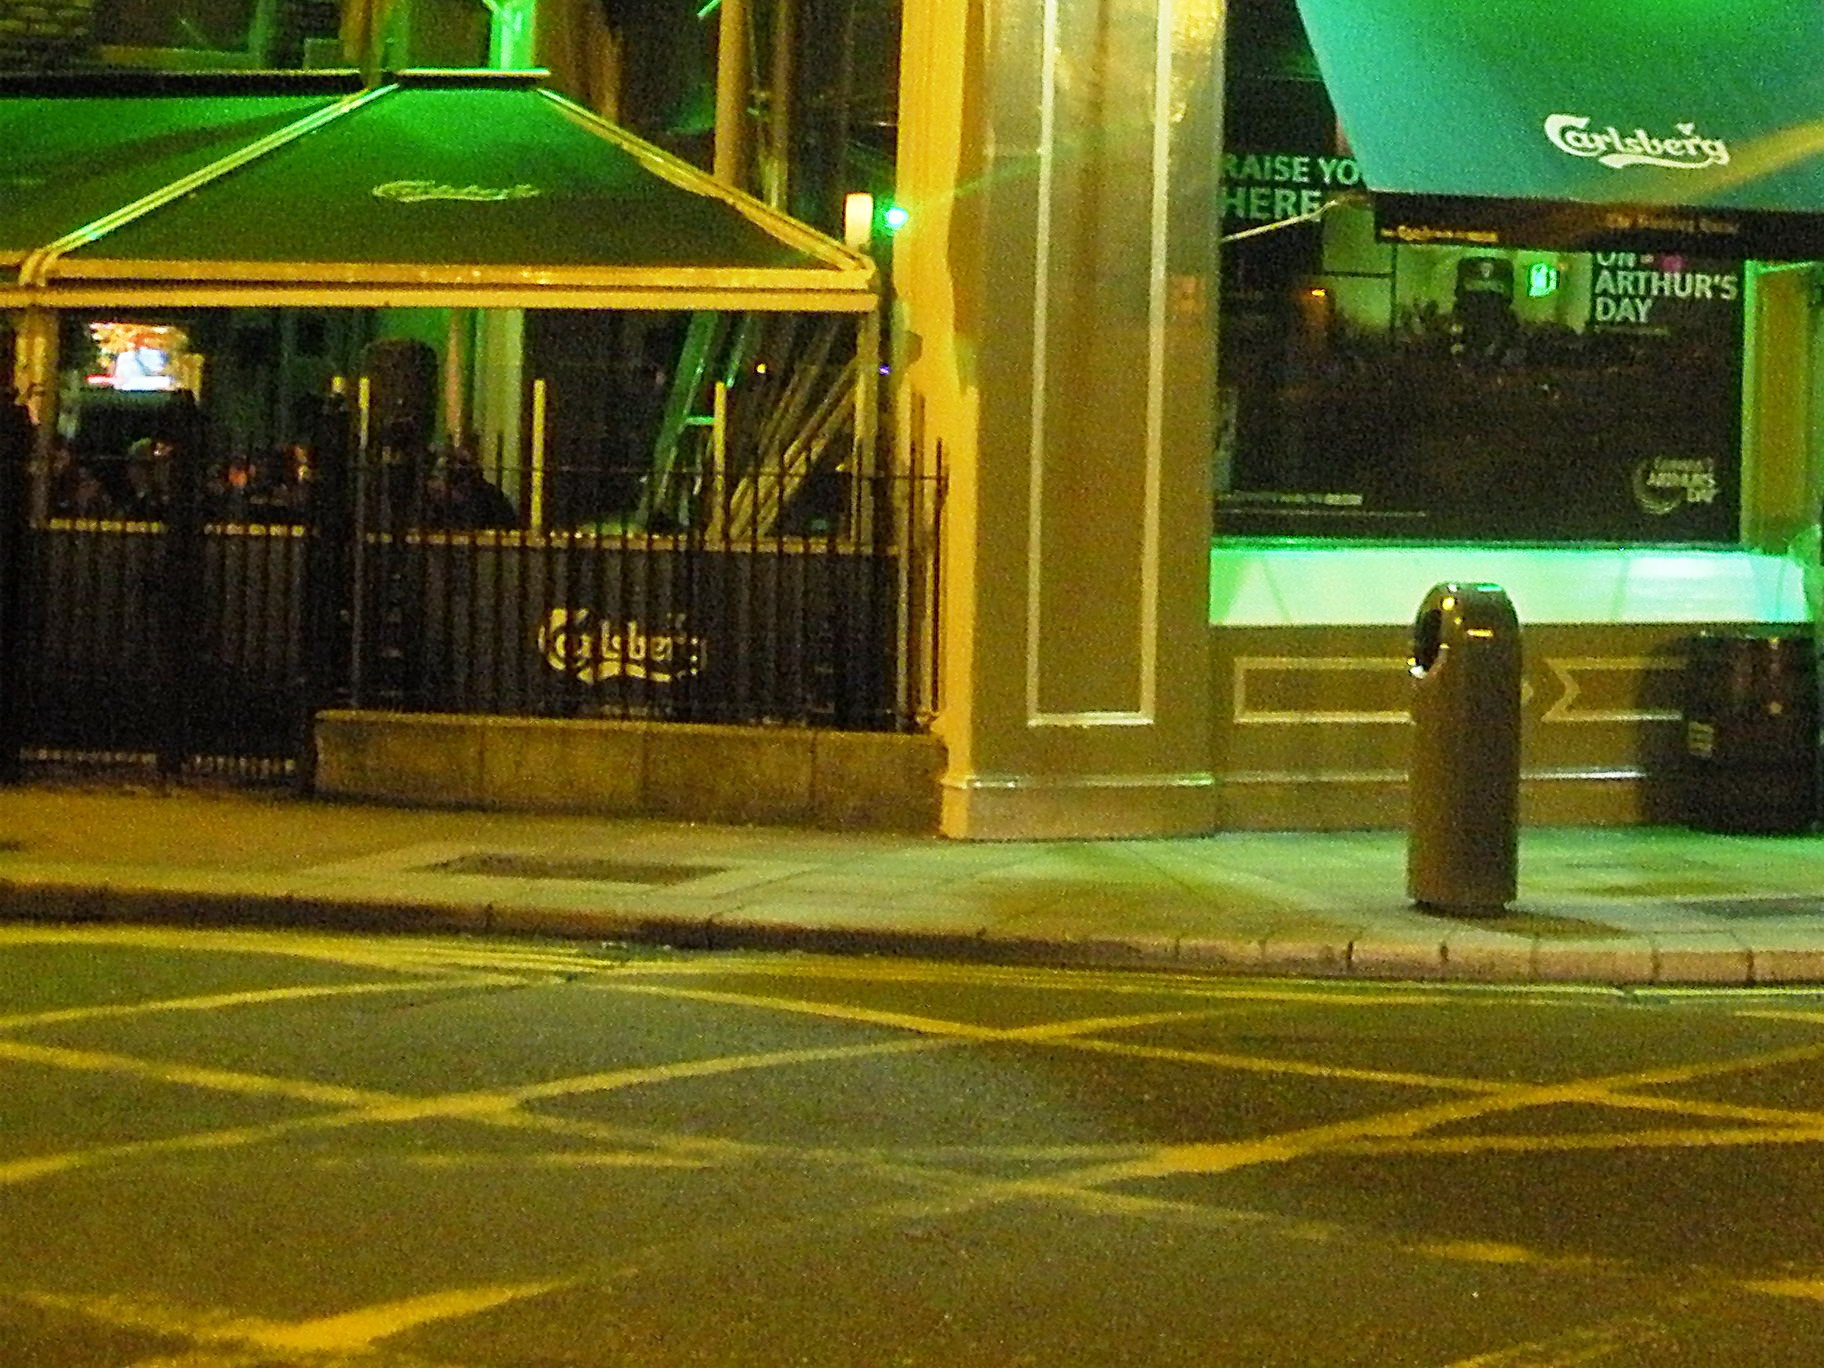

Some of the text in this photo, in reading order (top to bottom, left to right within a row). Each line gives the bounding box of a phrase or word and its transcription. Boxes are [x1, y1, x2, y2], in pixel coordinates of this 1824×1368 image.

[1544, 113, 1731, 169] Carlsberg
[1220, 153, 1311, 183] RAISE
[1220, 186, 1323, 222] HERE
[1595, 269, 1738, 300] ARTHUR'S
[1595, 296, 1653, 323] DAY
